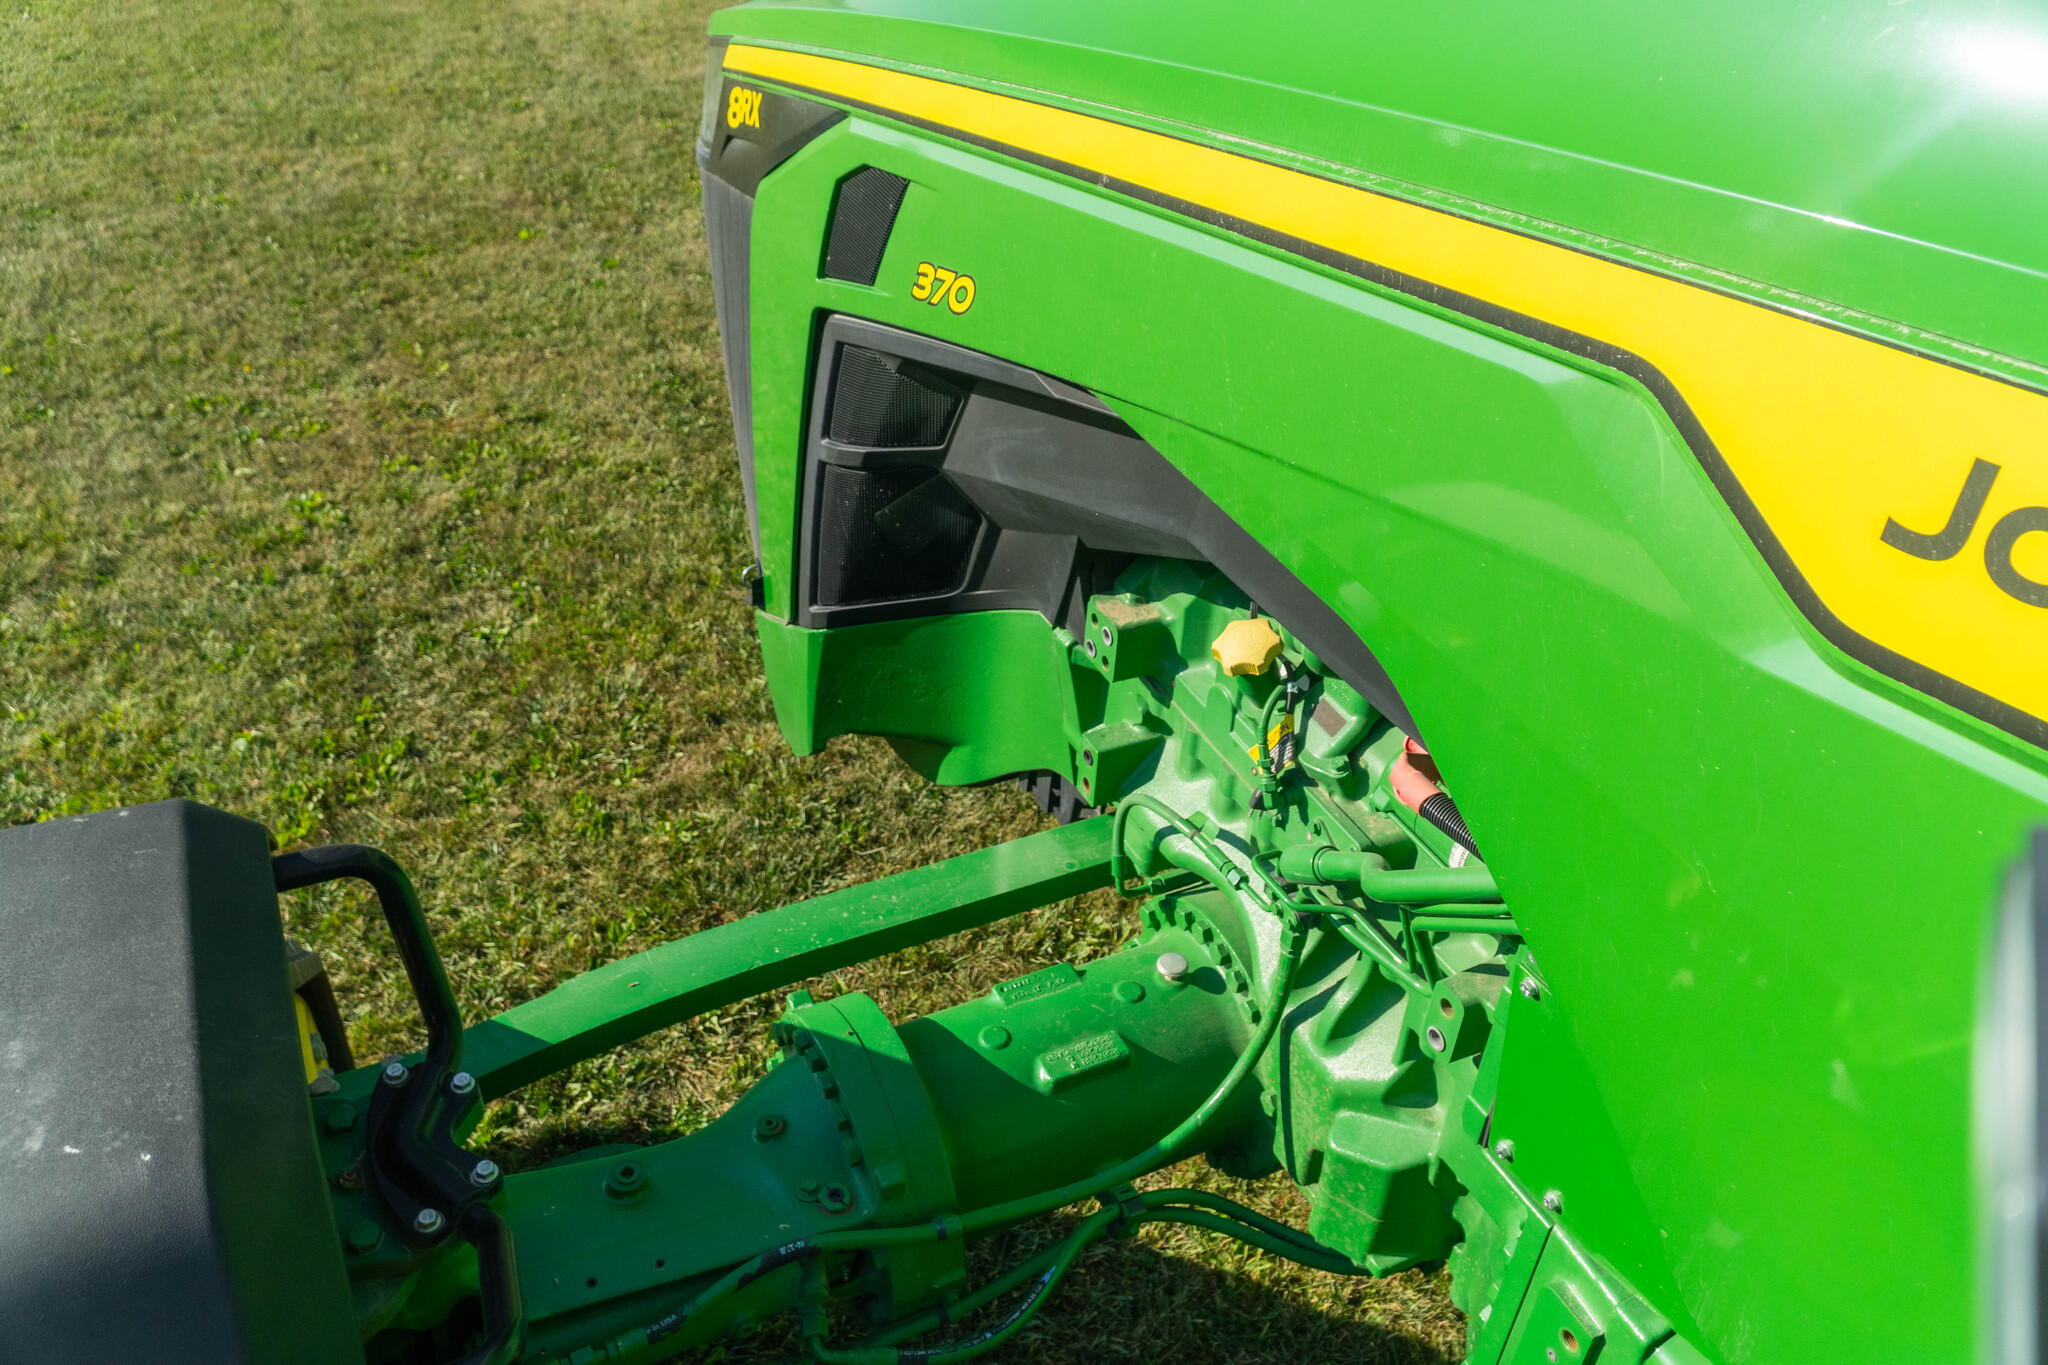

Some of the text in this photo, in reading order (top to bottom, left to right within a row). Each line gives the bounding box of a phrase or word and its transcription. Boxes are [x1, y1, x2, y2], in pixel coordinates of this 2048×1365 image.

[727, 86, 762, 129] 8RX
[911, 261, 976, 315] 370
[660, 1314, 678, 1327] USA
